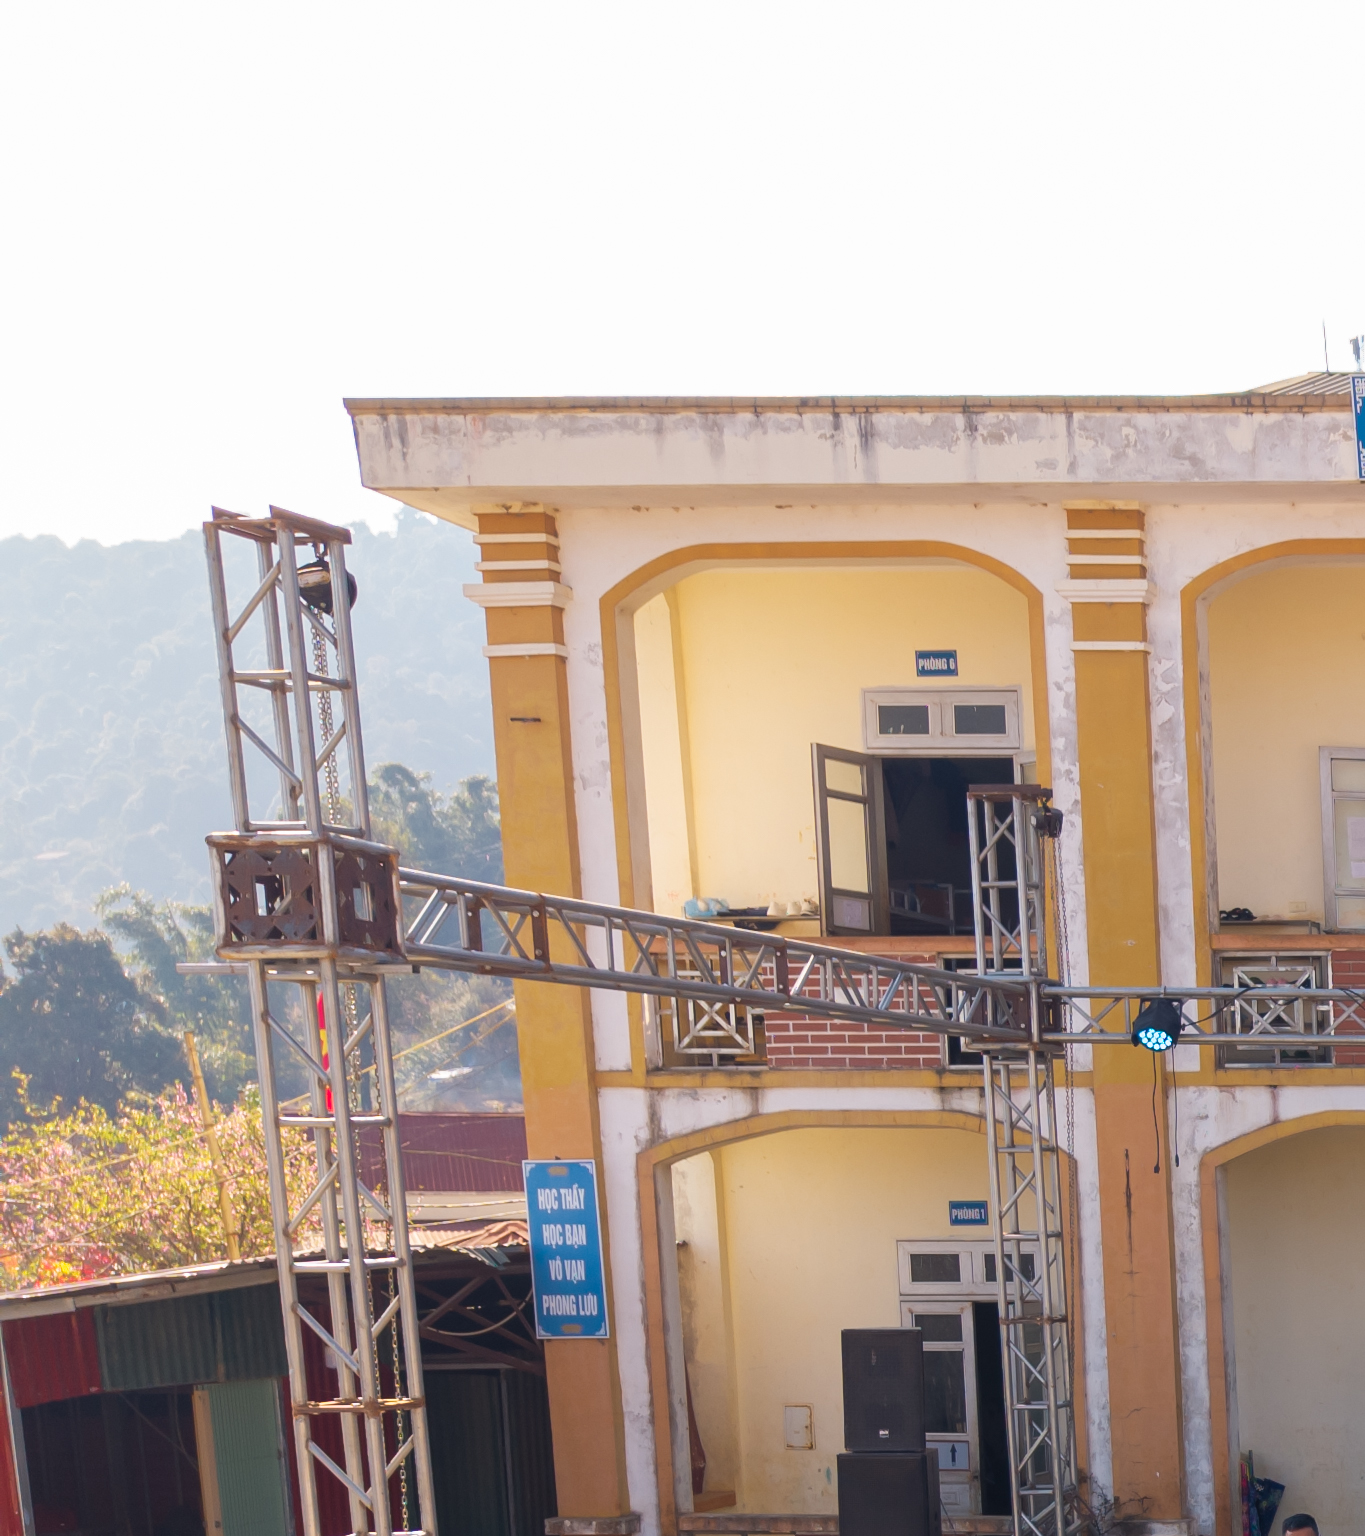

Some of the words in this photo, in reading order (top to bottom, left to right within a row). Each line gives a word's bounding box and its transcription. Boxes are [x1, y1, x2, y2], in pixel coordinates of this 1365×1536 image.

[918, 656, 947, 671] PHÒNG
[538, 1187, 558, 1213] HỌC
[951, 1206, 980, 1220] PHÒNG
[542, 1224, 563, 1248] HỌC
[565, 1224, 586, 1248] BẠN
[549, 1256, 563, 1281] VÔ
[542, 1294, 577, 1316] PHONG
